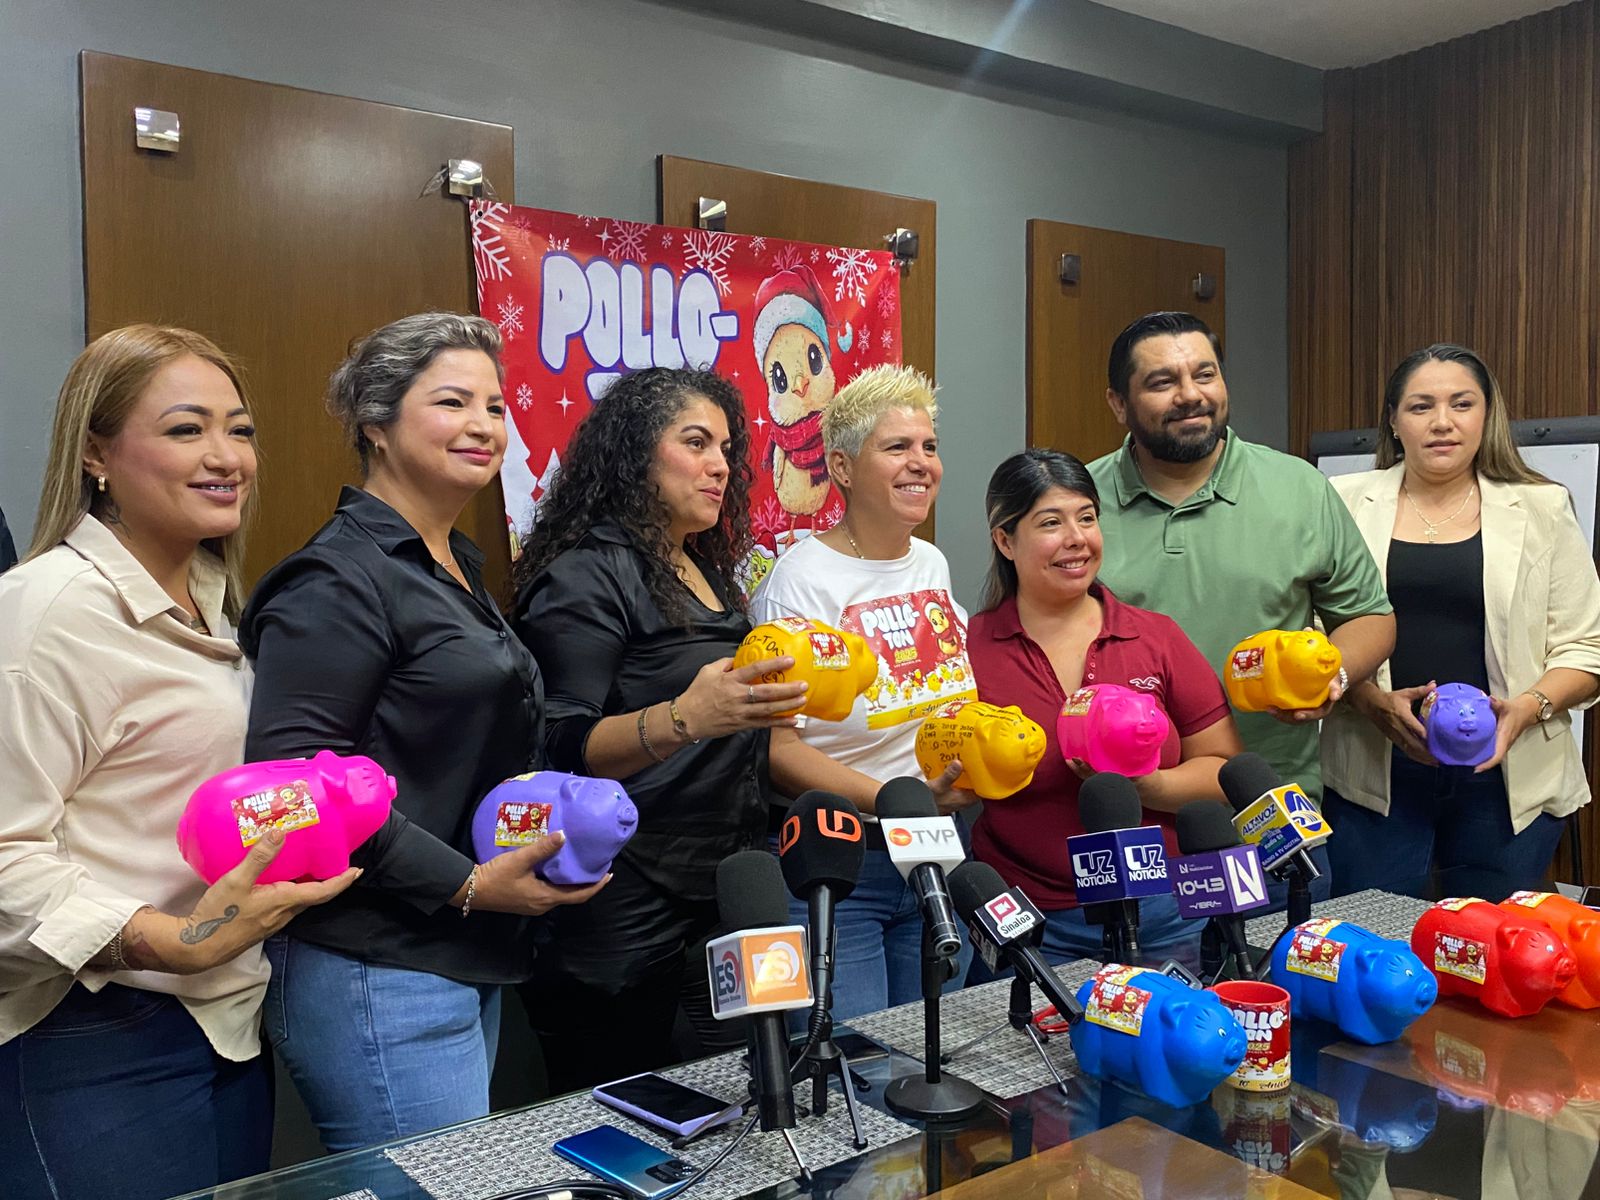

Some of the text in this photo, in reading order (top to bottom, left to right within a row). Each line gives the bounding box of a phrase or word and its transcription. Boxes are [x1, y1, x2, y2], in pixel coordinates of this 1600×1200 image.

[539, 252, 739, 374] POLLO-
[860, 603, 920, 638] POLLO-
[882, 629, 915, 650] TON
[1242, 803, 1278, 836] ALTAVOZ
[912, 829, 955, 844] TVP
[1076, 874, 1117, 888] NOTICIAS
[1128, 868, 1167, 882] NOTICIAS
[1177, 877, 1226, 896] 104.3
[1000, 914, 1032, 935] Sinaloa
[715, 961, 737, 997] ES
[1246, 1029, 1273, 1042] ON
[1248, 1043, 1270, 1051] 025
